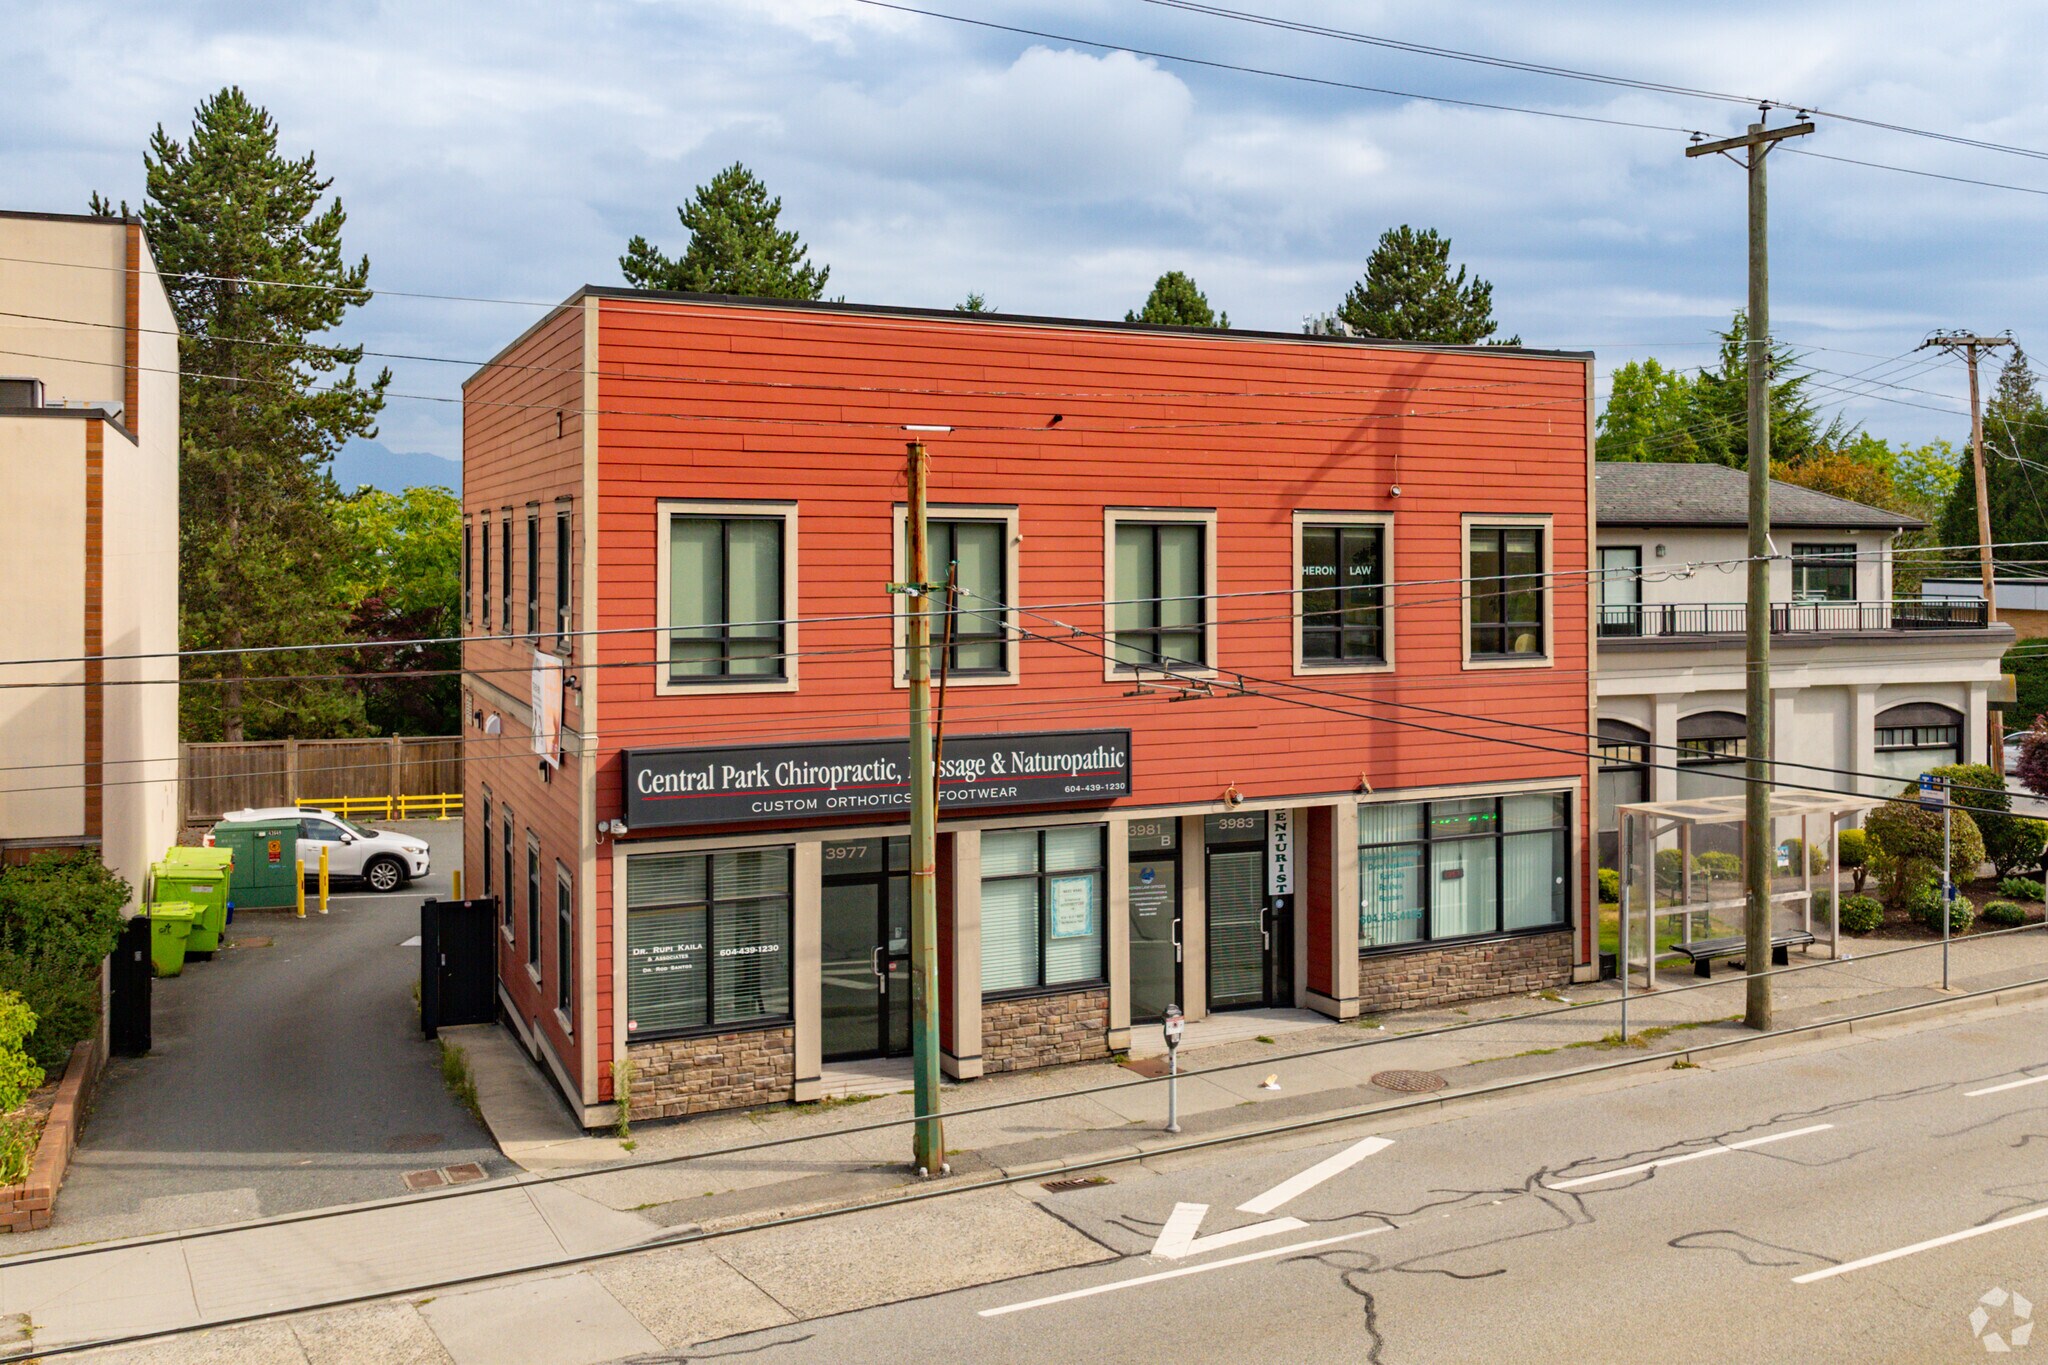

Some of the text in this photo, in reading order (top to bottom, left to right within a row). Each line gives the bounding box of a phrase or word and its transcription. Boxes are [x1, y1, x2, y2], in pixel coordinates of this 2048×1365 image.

[1302, 566, 1372, 576] HERON LAW
[637, 745, 1125, 794] Central Park Chiropractic, ssage & Naturopathic
[1064, 782, 1126, 793] 604-439-1230
[751, 786, 1018, 813] CUSTOM ORTHOTICS FOOTWEAR
[1128, 823, 1161, 837] 3981
[1218, 817, 1255, 830] 3983
[1161, 835, 1171, 847] B
[825, 845, 868, 860] 3977
[1274, 808, 1288, 894] ENTURIST
[632, 948, 649, 956] DR.
[719, 944, 780, 957] 604-439-1230
